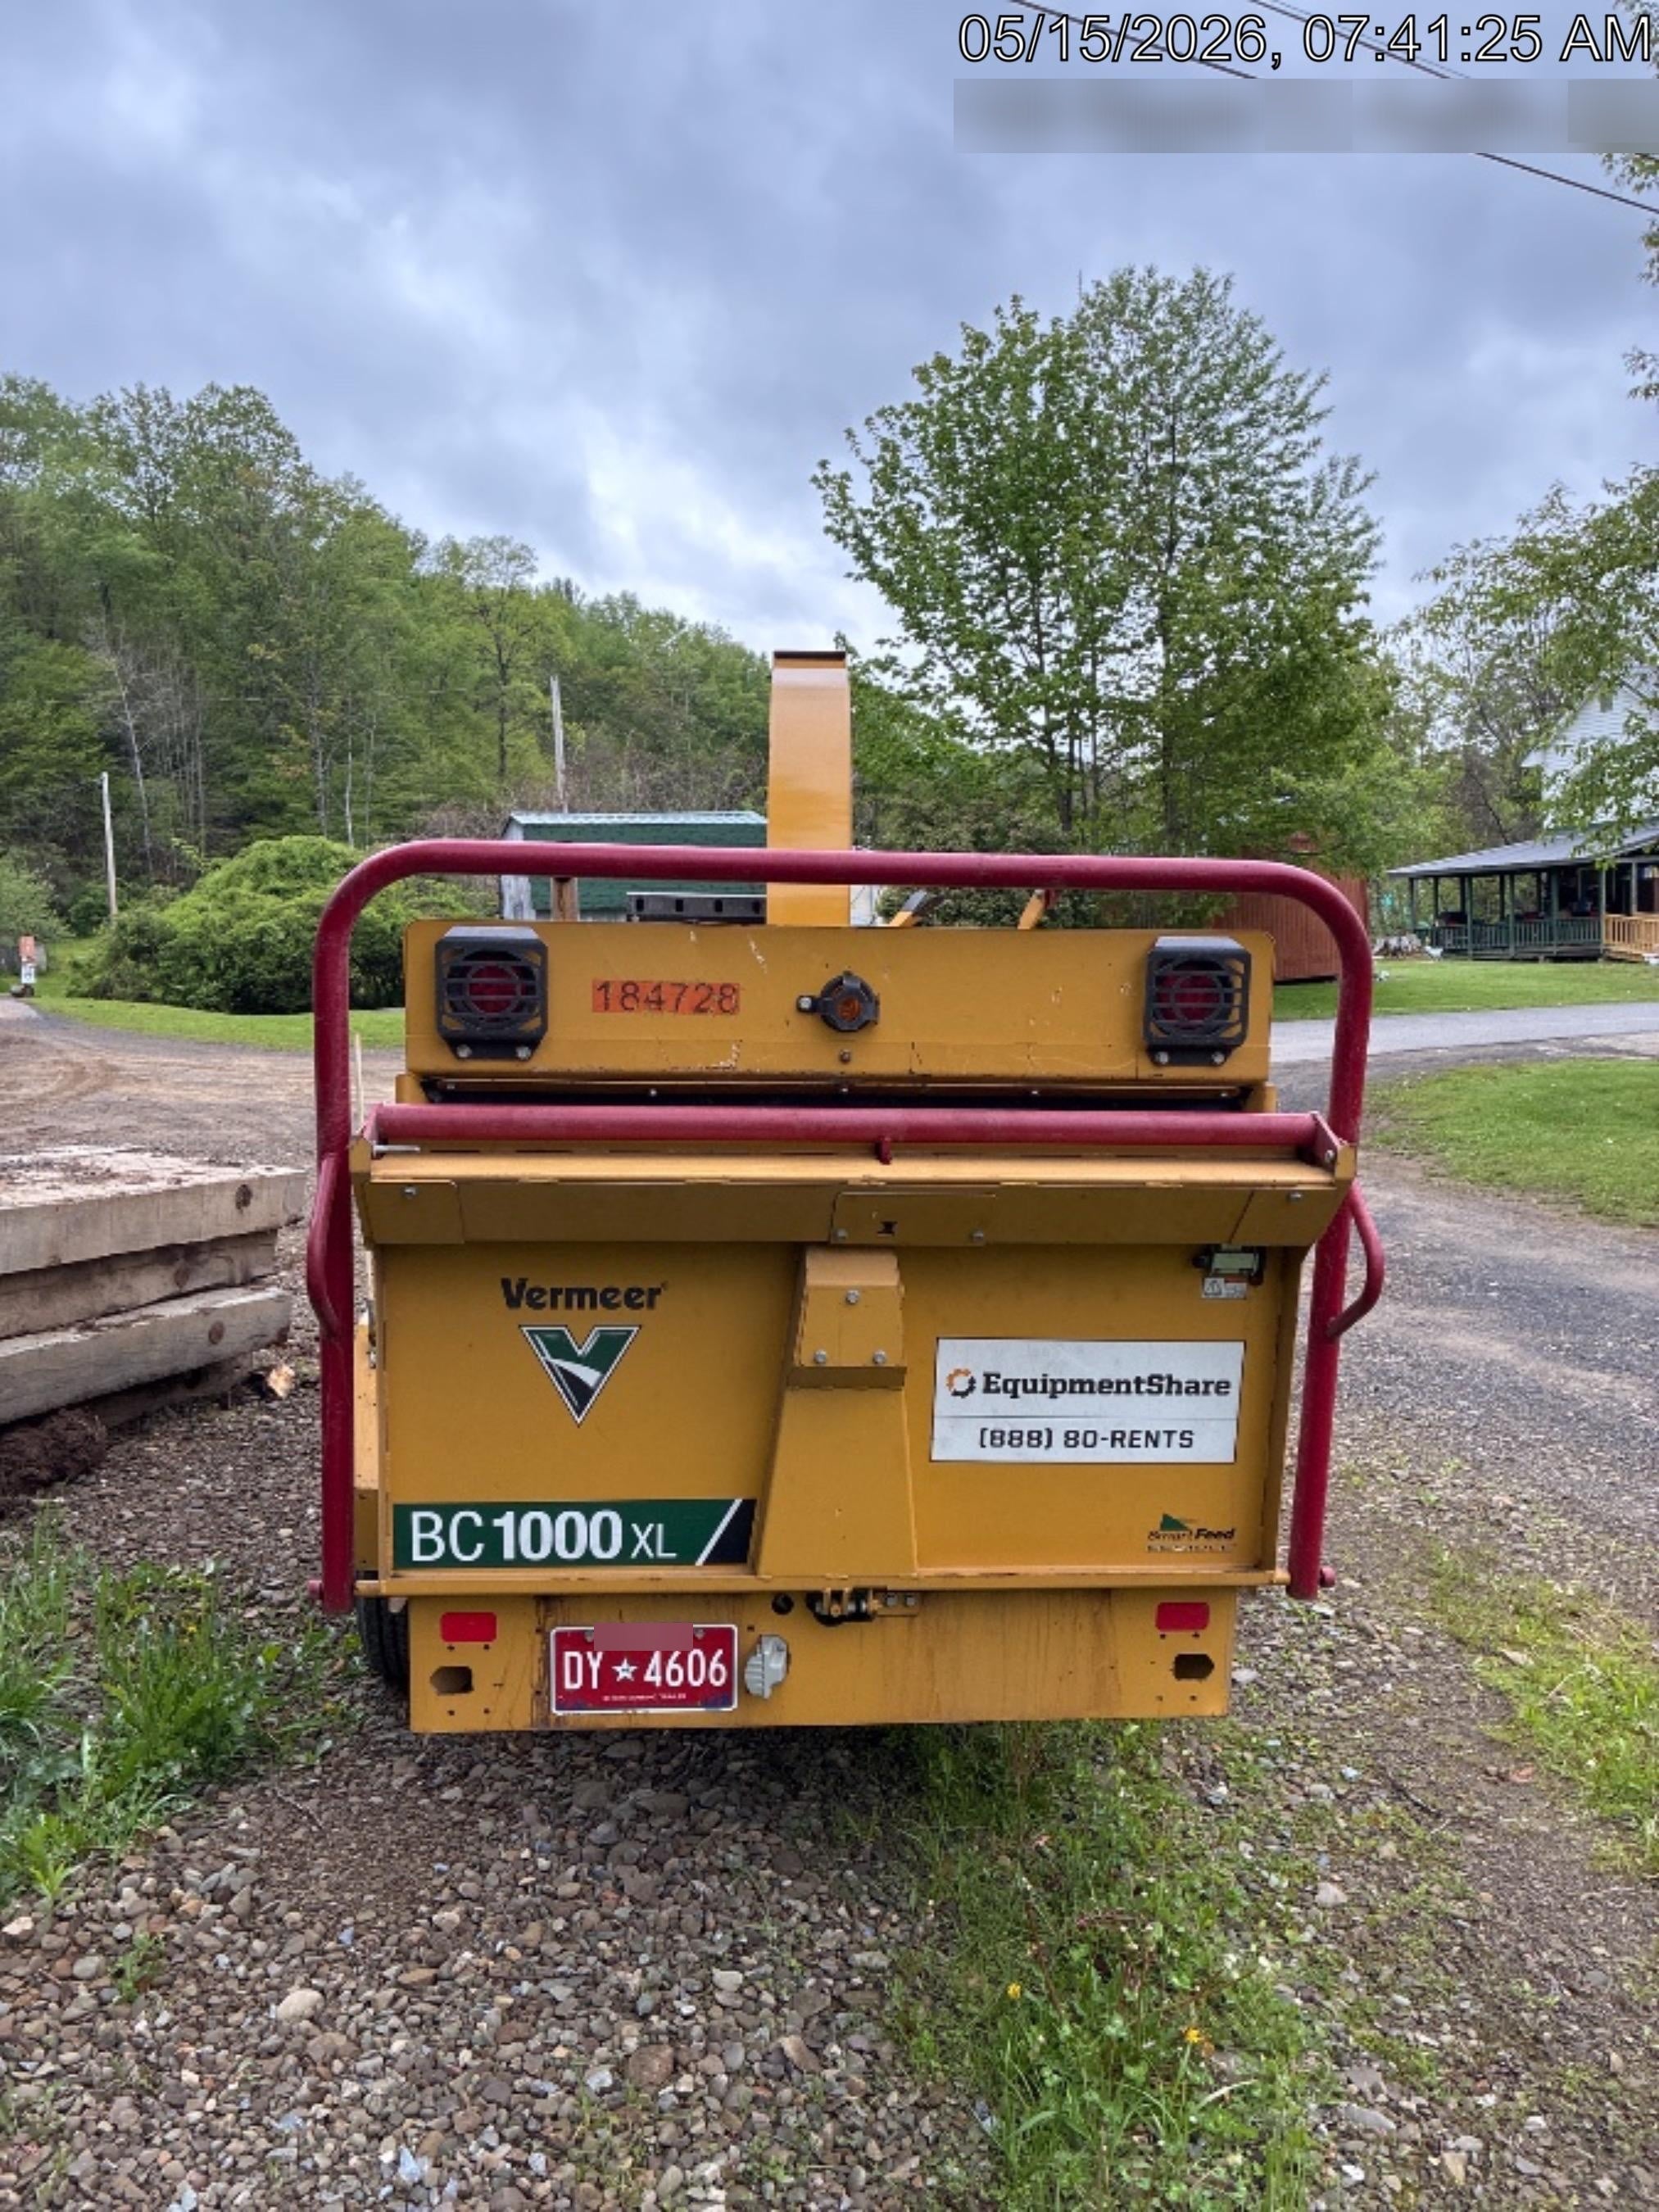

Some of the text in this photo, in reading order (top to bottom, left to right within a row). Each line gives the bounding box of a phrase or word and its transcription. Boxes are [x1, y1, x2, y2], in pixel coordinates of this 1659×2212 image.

[596, 981, 737, 1014] 184728
[501, 1277, 664, 1311] Vermeer
[982, 1371, 1232, 1399] EquipmentShare
[979, 1427, 1196, 1450] (888) 80-RENTS
[564, 1648, 728, 1690] DY 4606
